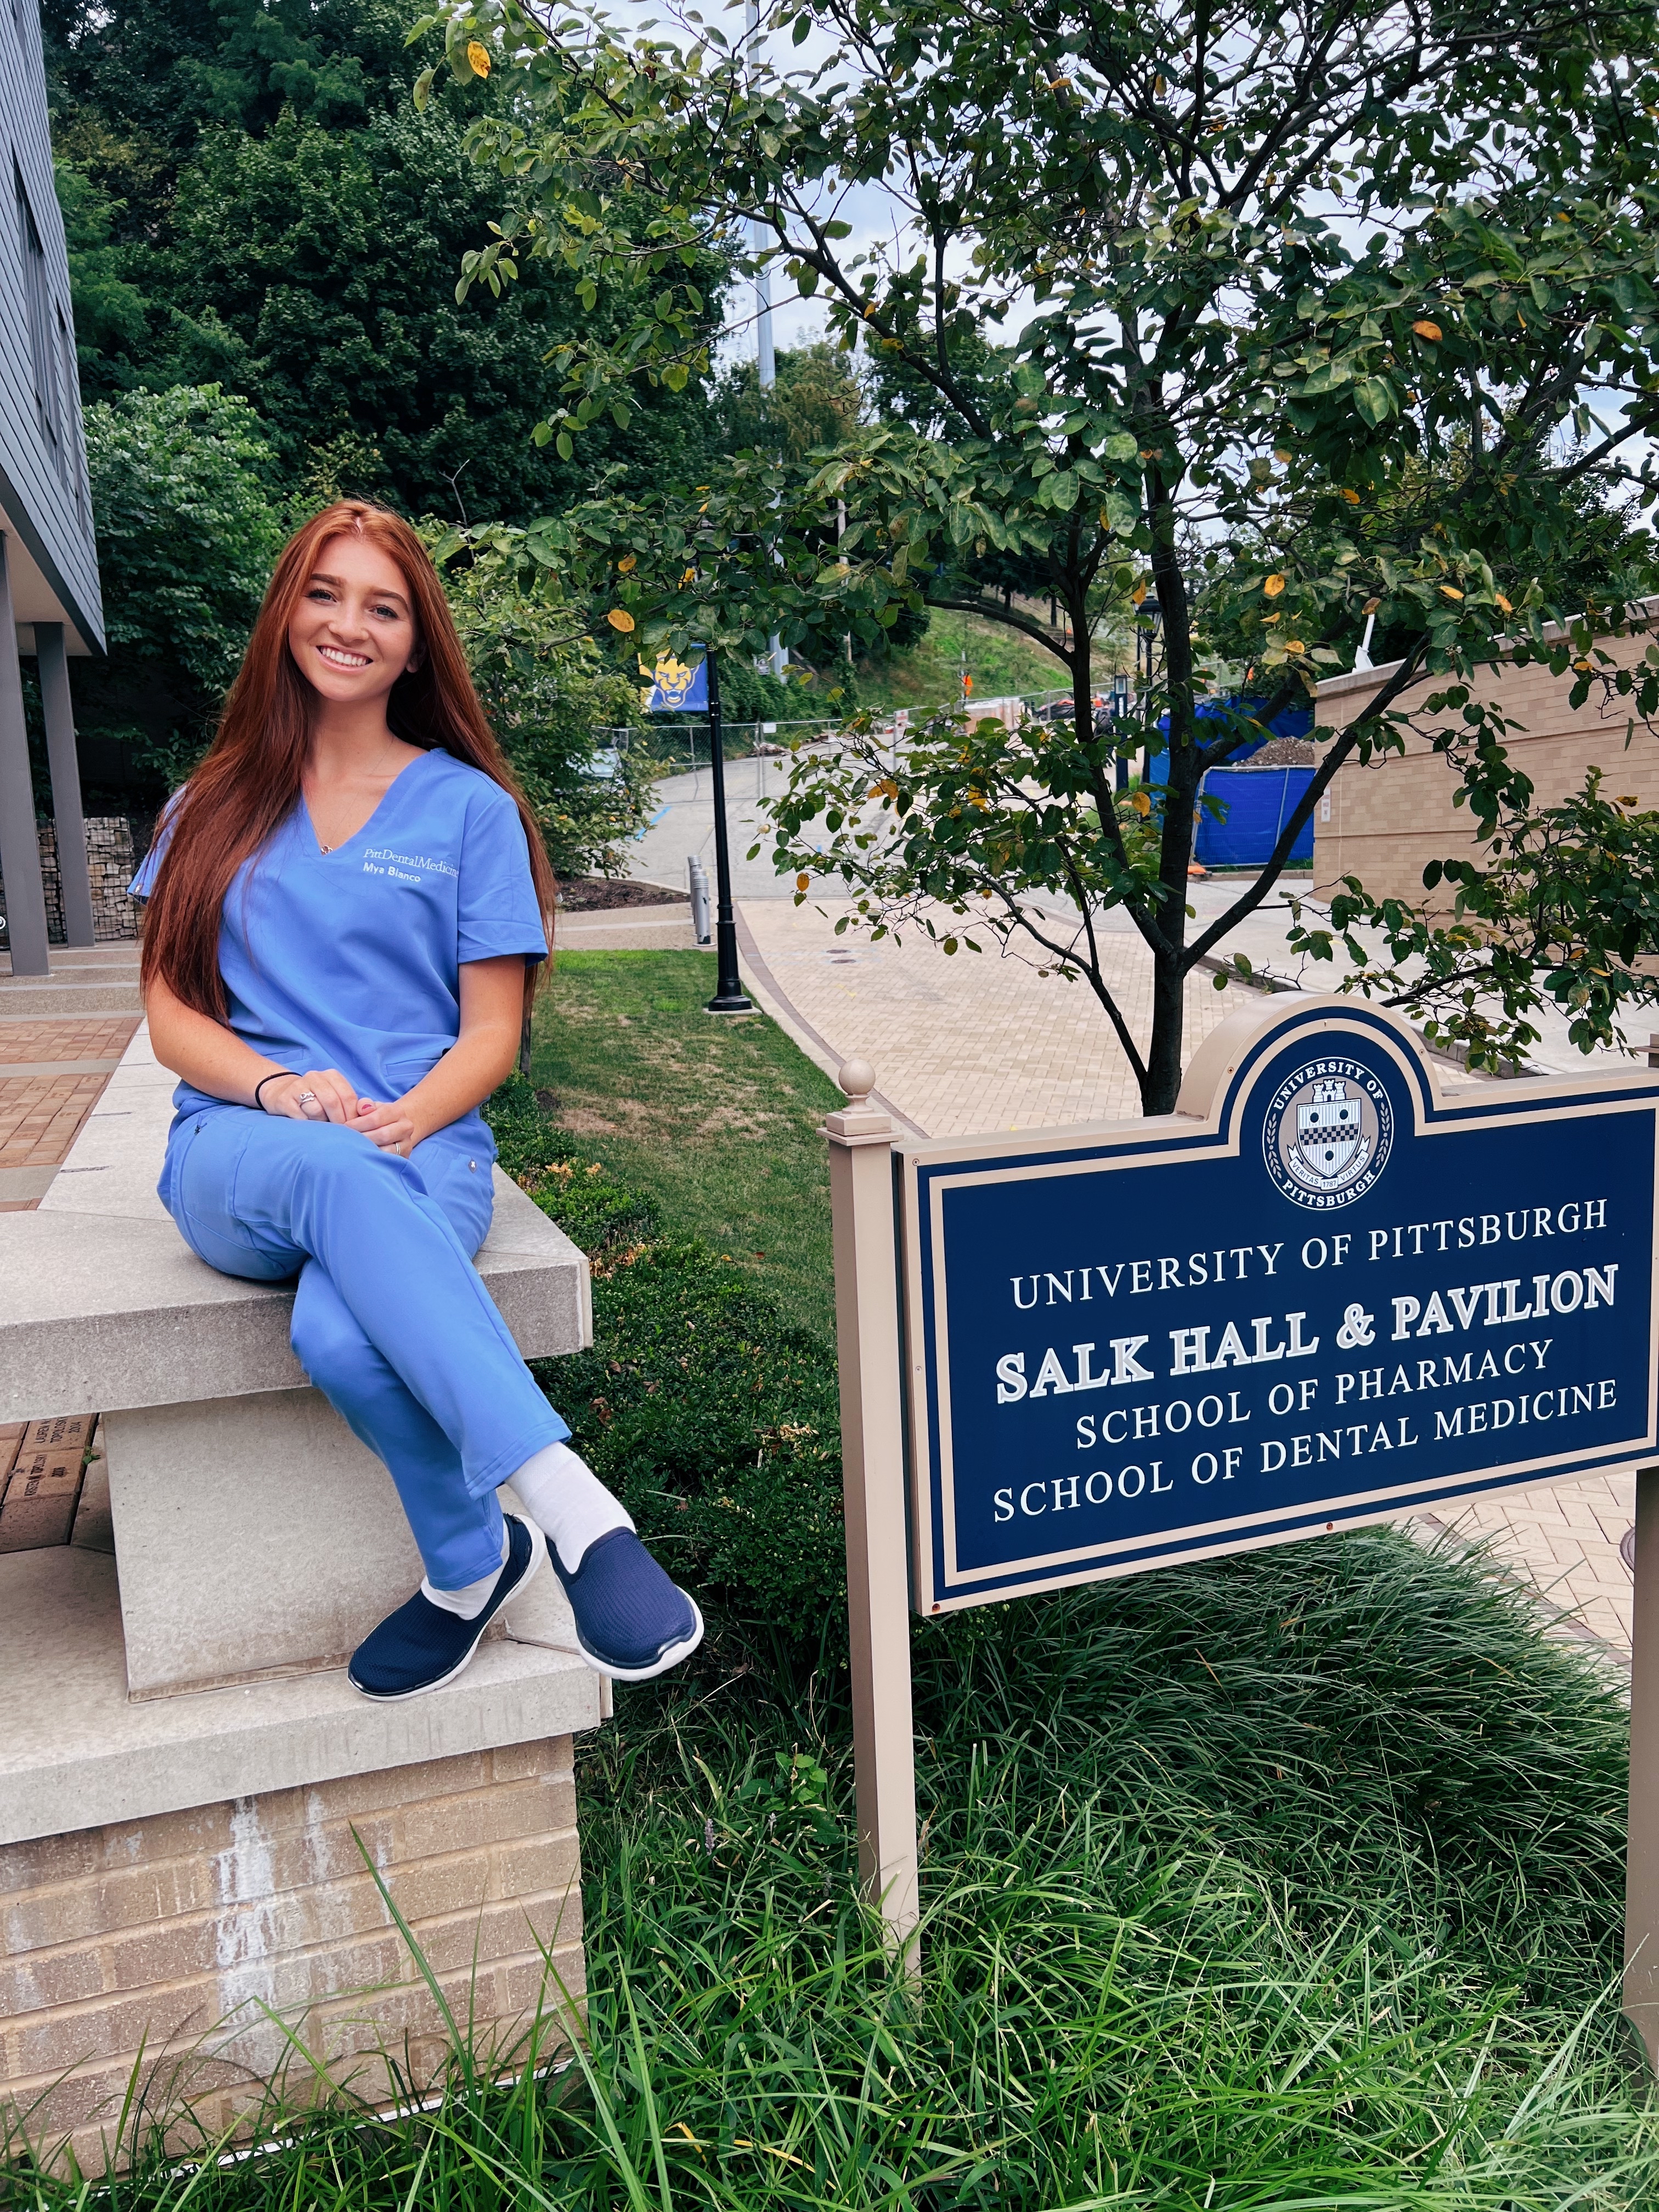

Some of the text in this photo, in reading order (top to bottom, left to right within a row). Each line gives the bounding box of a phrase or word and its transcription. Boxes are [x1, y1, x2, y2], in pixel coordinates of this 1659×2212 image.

[363, 862, 421, 882] Mya Blanco
[1273, 1061, 1384, 1110] UNIVERSITY OF
[1282, 1170, 1376, 1207] PITTSBURGH
[1292, 1155, 1365, 1188] VERITAS 1787 VIRTUS
[1009, 1199, 1607, 1309] UNIVERSITY OF PITTSBURGH
[995, 1263, 1619, 1405] SALK HALL & PAVILION
[1076, 1339, 1553, 1449] SCHOOL OF PHARMACY
[994, 1379, 1617, 1522] SCHOOL OF DENTAL MEDICINE
